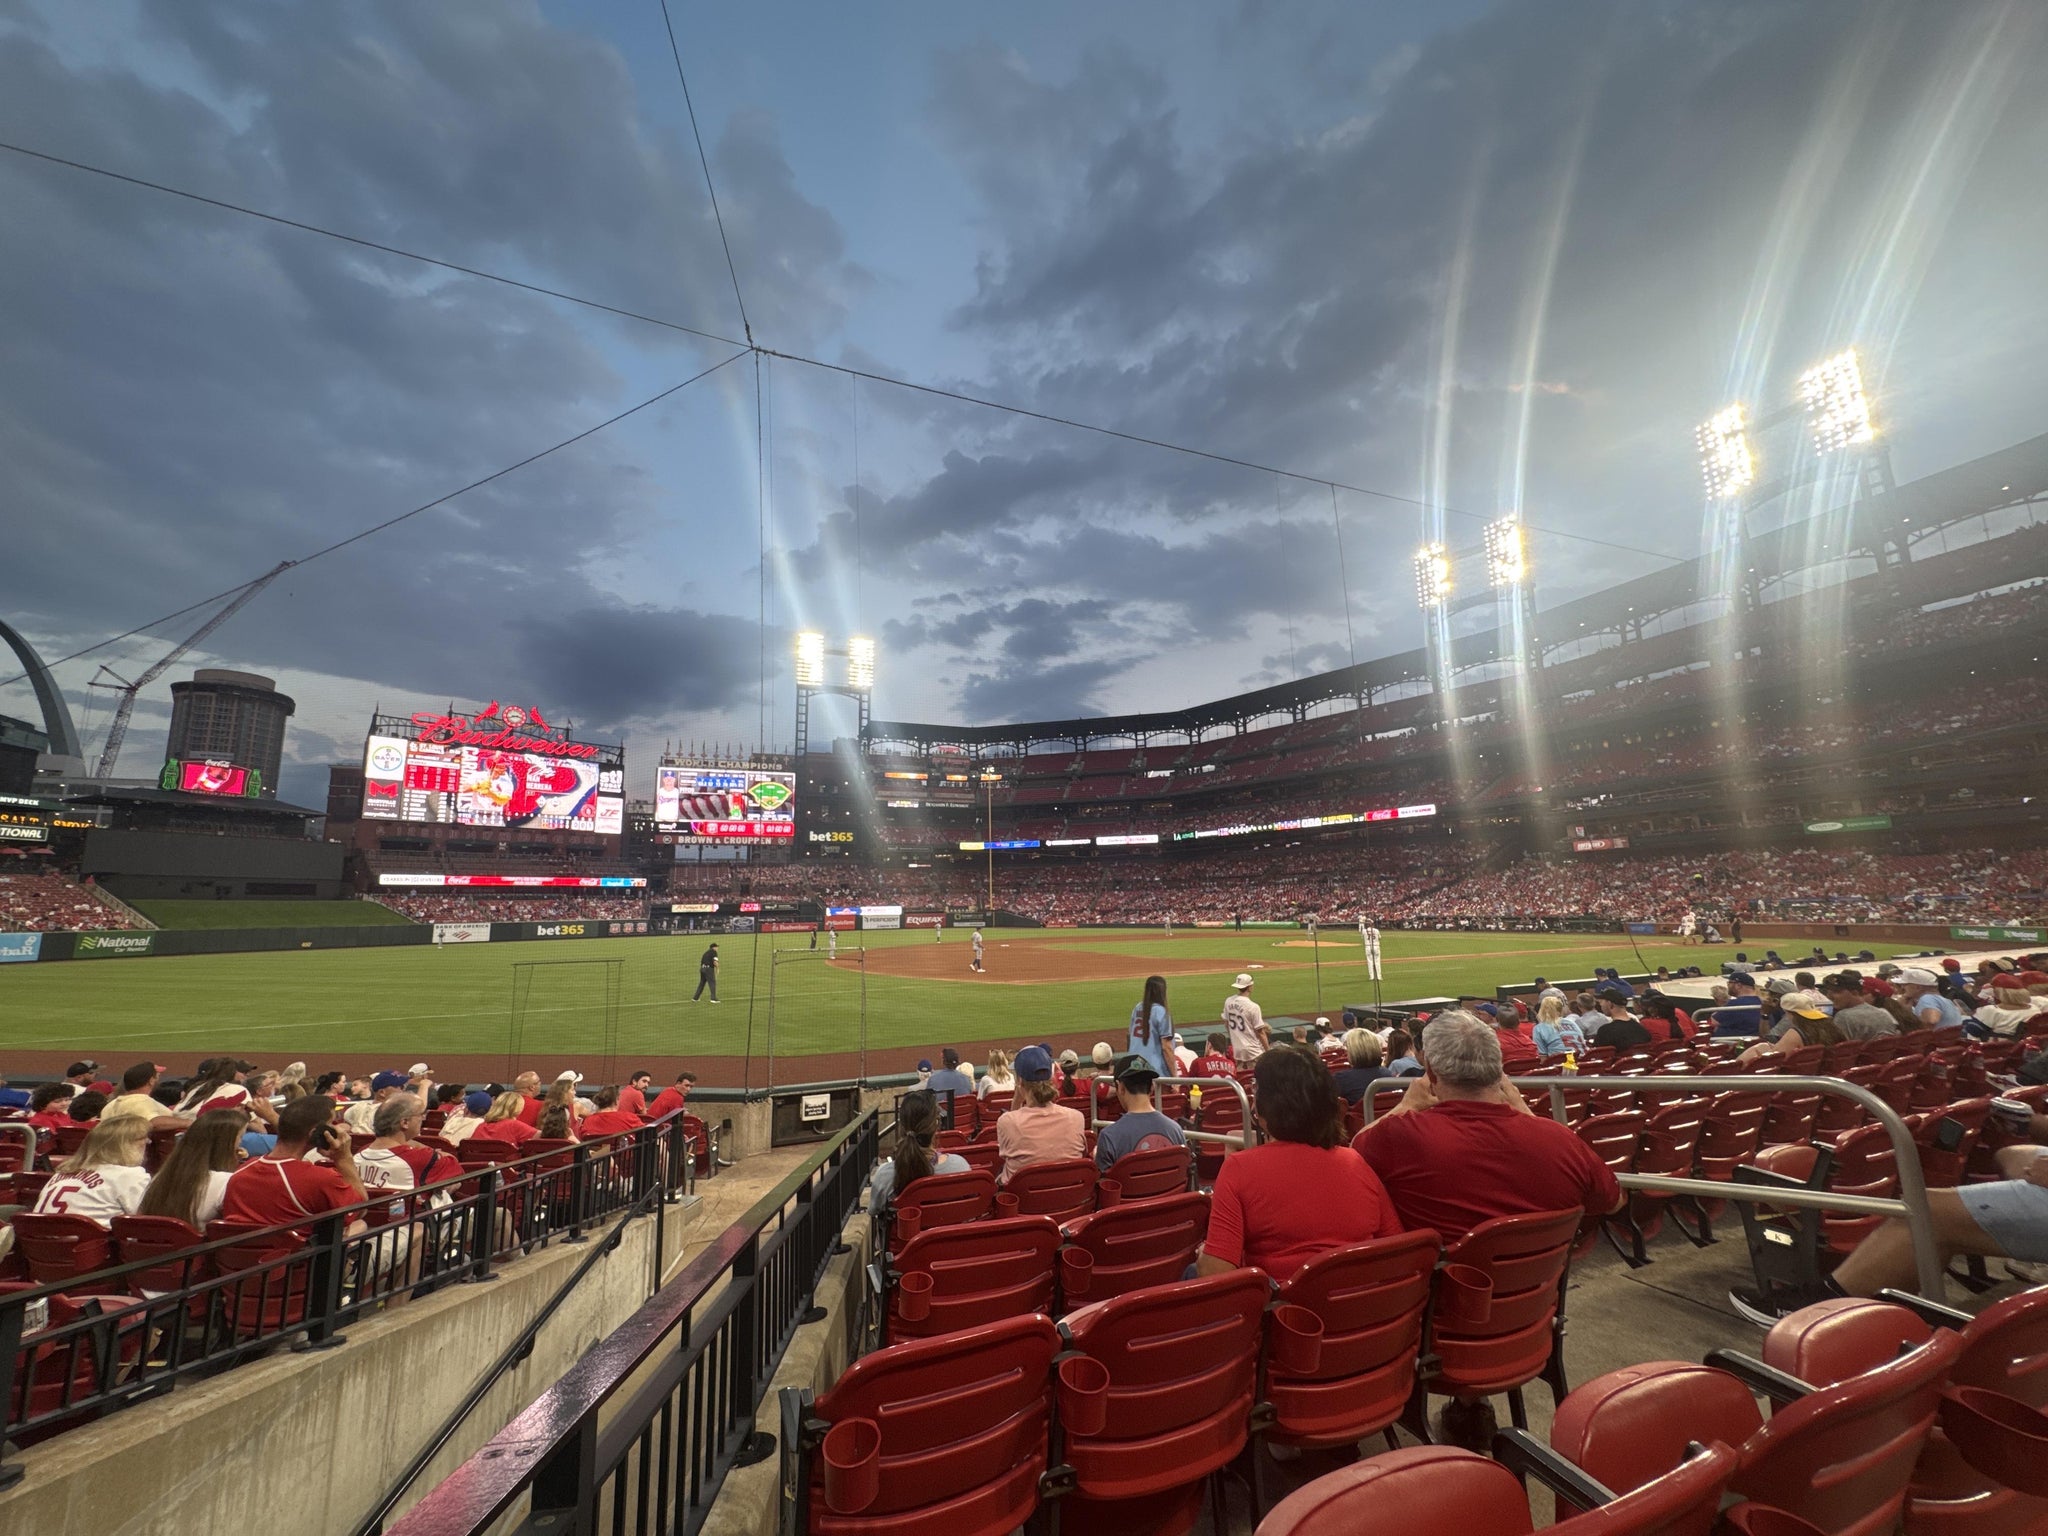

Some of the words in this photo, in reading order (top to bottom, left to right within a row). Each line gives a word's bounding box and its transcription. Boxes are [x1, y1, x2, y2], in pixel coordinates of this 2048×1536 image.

[411, 712, 599, 758] Budweiser
[674, 760, 716, 768] WORLD
[718, 761, 783, 770] CHAMPIONS
[18, 798, 40, 806] DECK
[678, 836, 713, 844] BROWN
[724, 836, 772, 845] CROUPPEN
[809, 831, 854, 842] bet365
[906, 916, 943, 925] EQUIFAX
[537, 924, 584, 936] bet365
[97, 937, 150, 948] National
[1229, 1013, 1245, 1031] 53
[38, 1186, 81, 1214] 15
